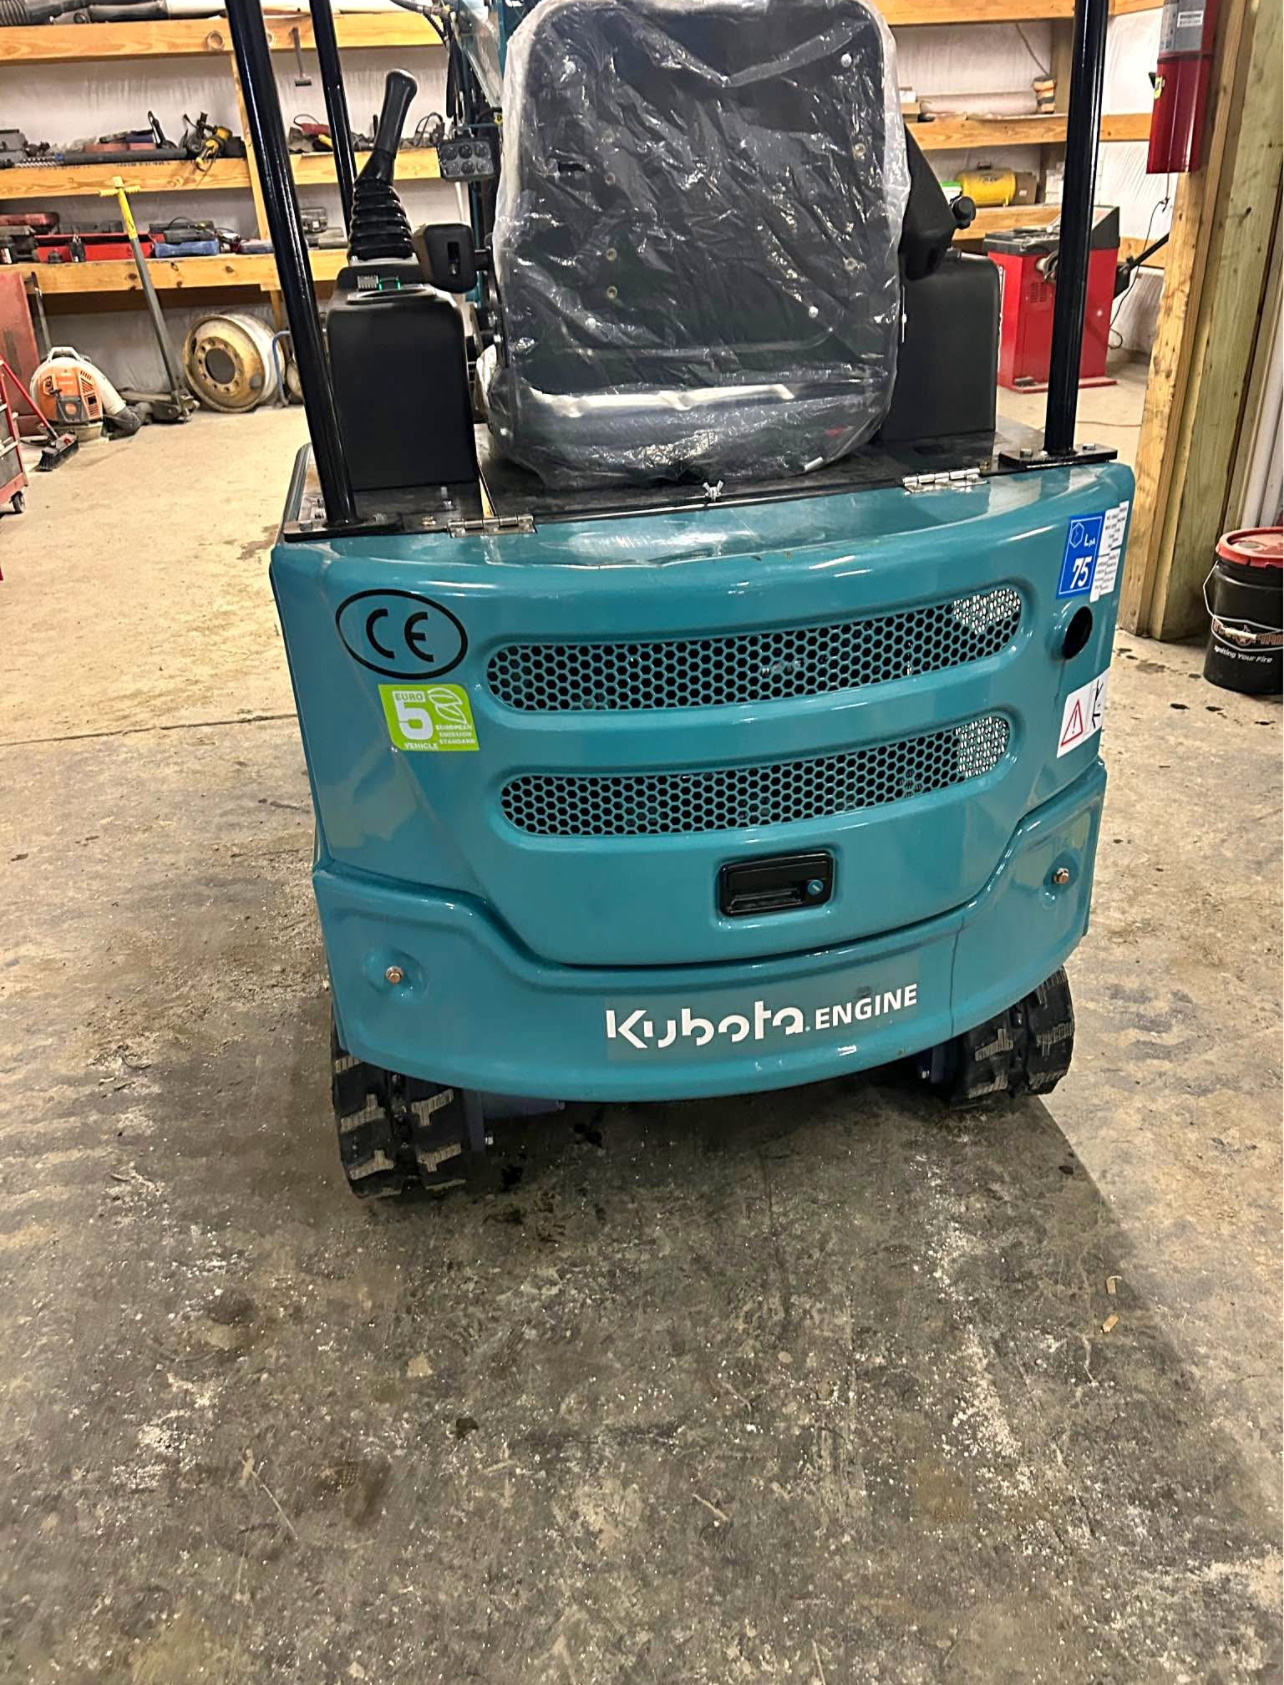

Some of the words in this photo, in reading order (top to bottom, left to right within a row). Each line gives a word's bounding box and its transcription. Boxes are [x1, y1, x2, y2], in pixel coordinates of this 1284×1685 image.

[1069, 556, 1093, 590] 75
[366, 608, 434, 662] CE
[1237, 653, 1256, 662] Your
[1255, 656, 1273, 664] Fire
[394, 692, 424, 702] EURO
[395, 701, 434, 740] 5
[404, 743, 438, 751] VEHICLE
[606, 1000, 804, 1049] Kubota
[815, 983, 918, 1031] ENGINE
